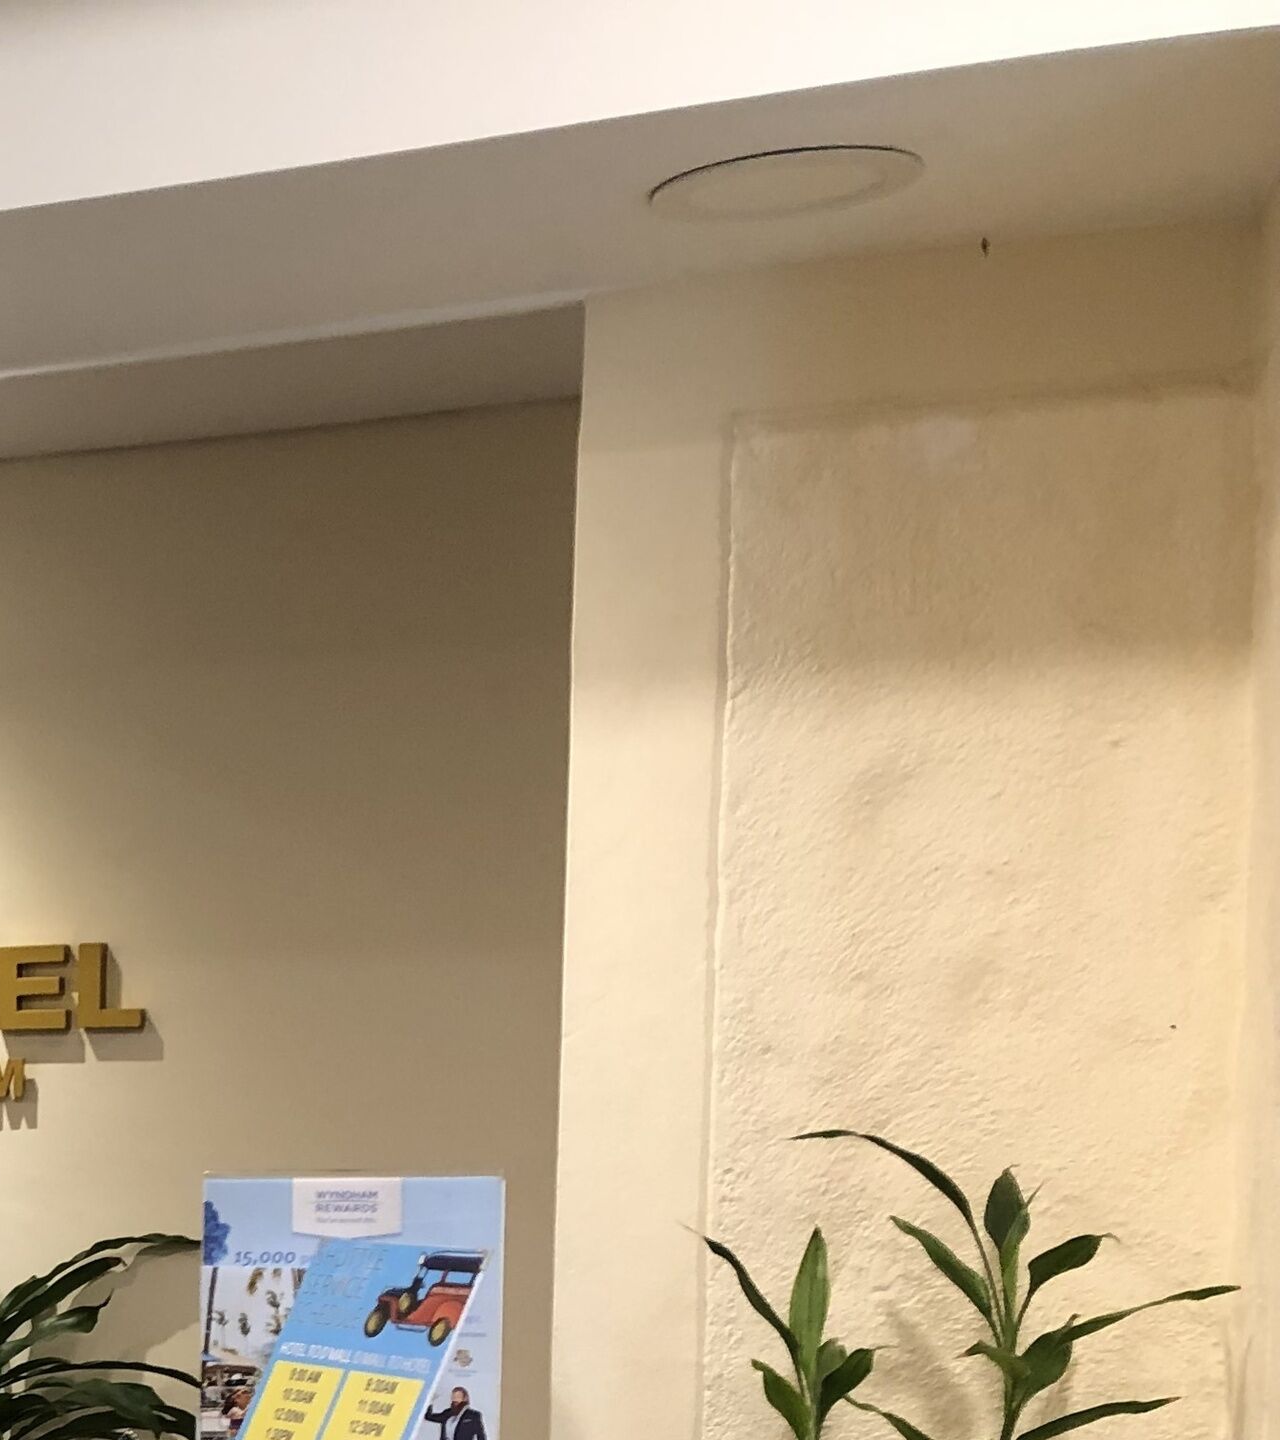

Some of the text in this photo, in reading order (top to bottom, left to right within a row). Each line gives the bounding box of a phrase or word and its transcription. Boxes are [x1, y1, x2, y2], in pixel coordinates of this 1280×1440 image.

[315, 1190, 379, 1200] WYNDHAM
[315, 1203, 378, 1214] REWARDS
[235, 1250, 297, 1267] 15,000
